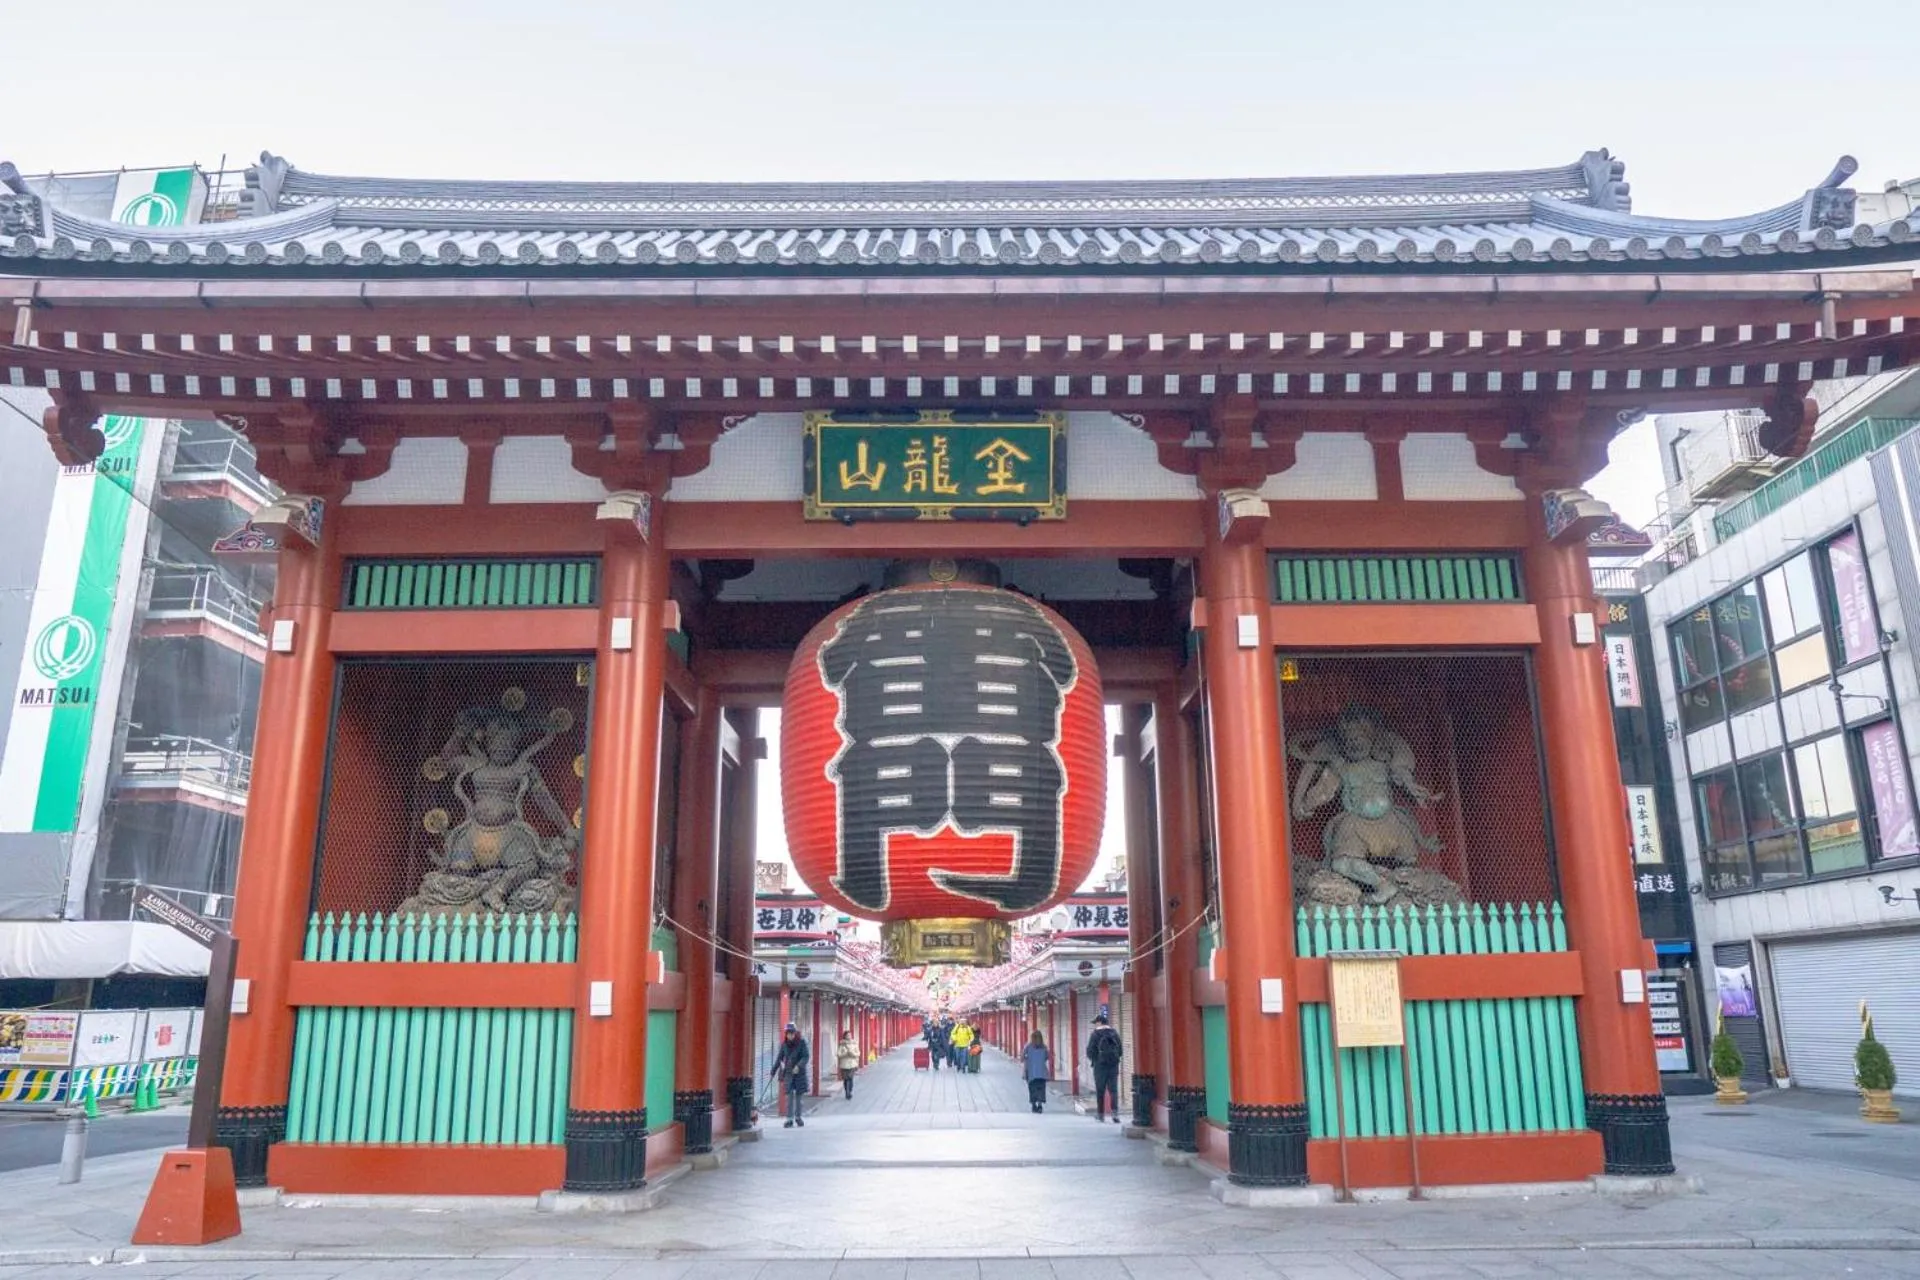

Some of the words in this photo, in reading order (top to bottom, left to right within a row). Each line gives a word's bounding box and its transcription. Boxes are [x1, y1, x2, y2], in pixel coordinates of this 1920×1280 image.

[20, 687, 90, 704] MATSUI
[1633, 873, 1676, 893] 直送
[194, 923, 216, 940] GATE
